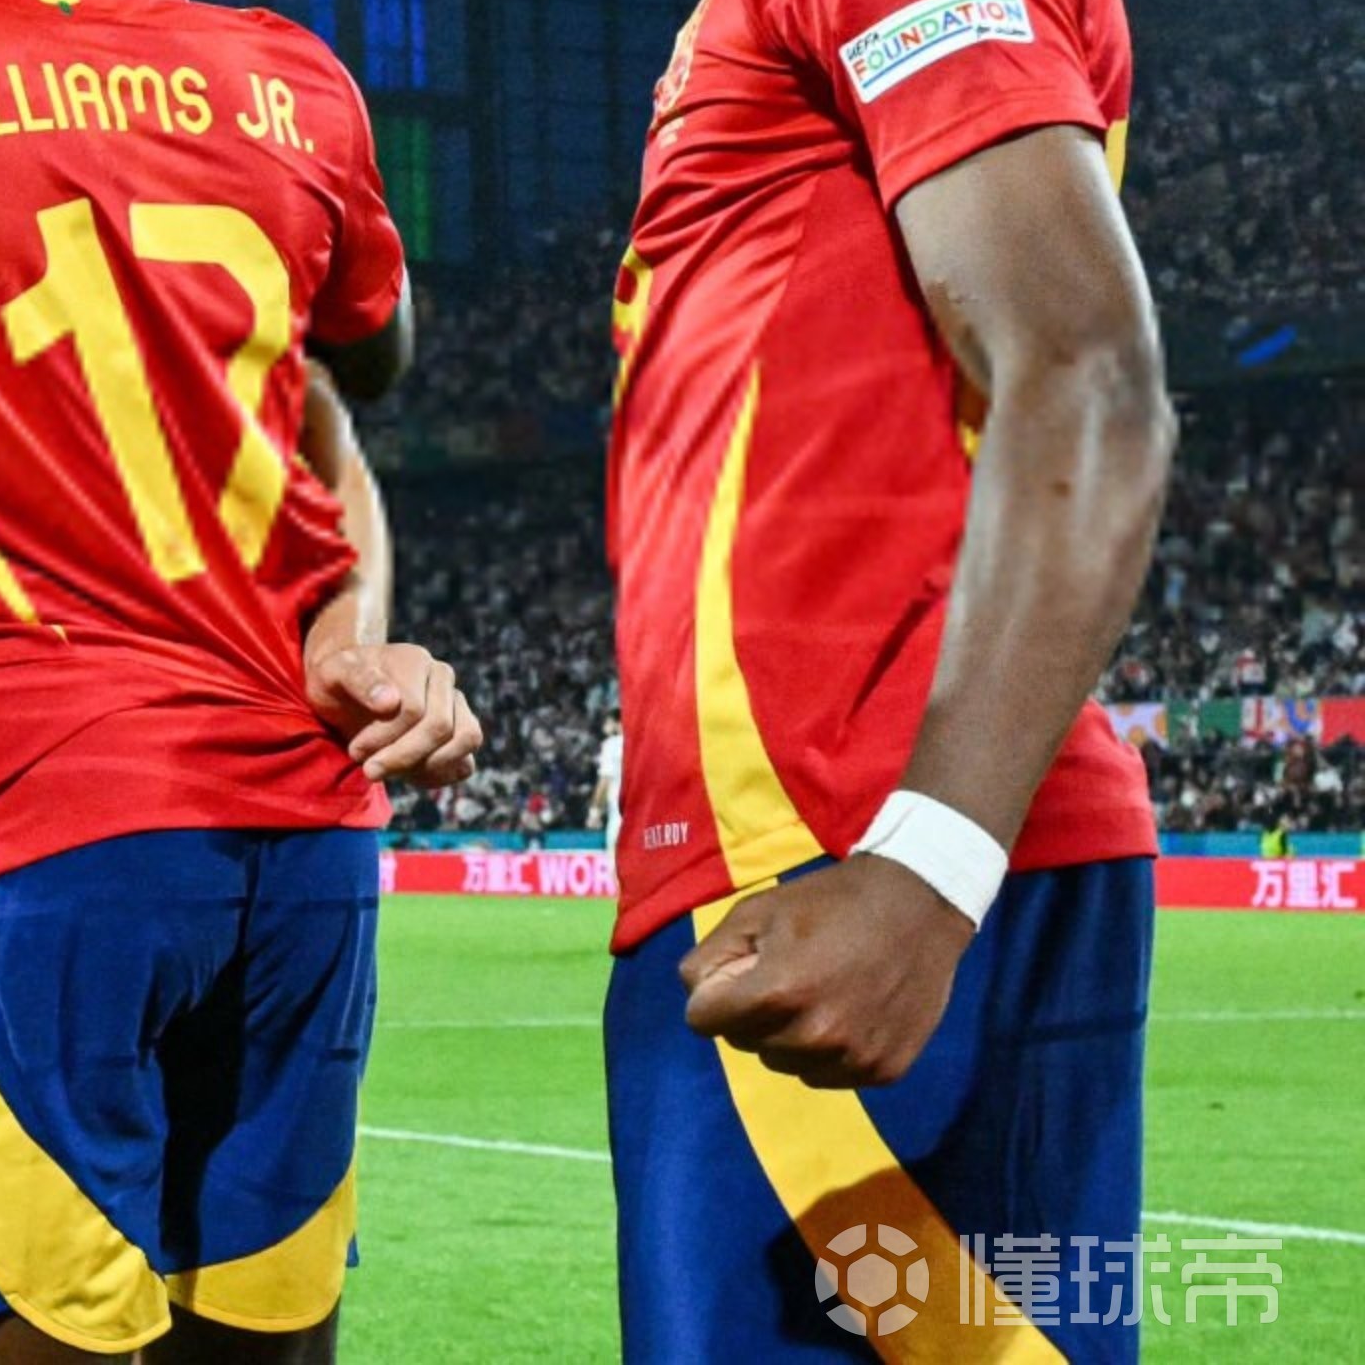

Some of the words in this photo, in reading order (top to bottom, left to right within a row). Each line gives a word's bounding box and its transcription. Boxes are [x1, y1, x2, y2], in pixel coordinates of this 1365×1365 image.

[846, 31, 880, 61] UEFA
[853, 1, 1023, 81] FOUNDATION
[237, 73, 315, 153] JR.
[1, 198, 291, 583] 17
[1250, 860, 1357, 907] 万里汇
